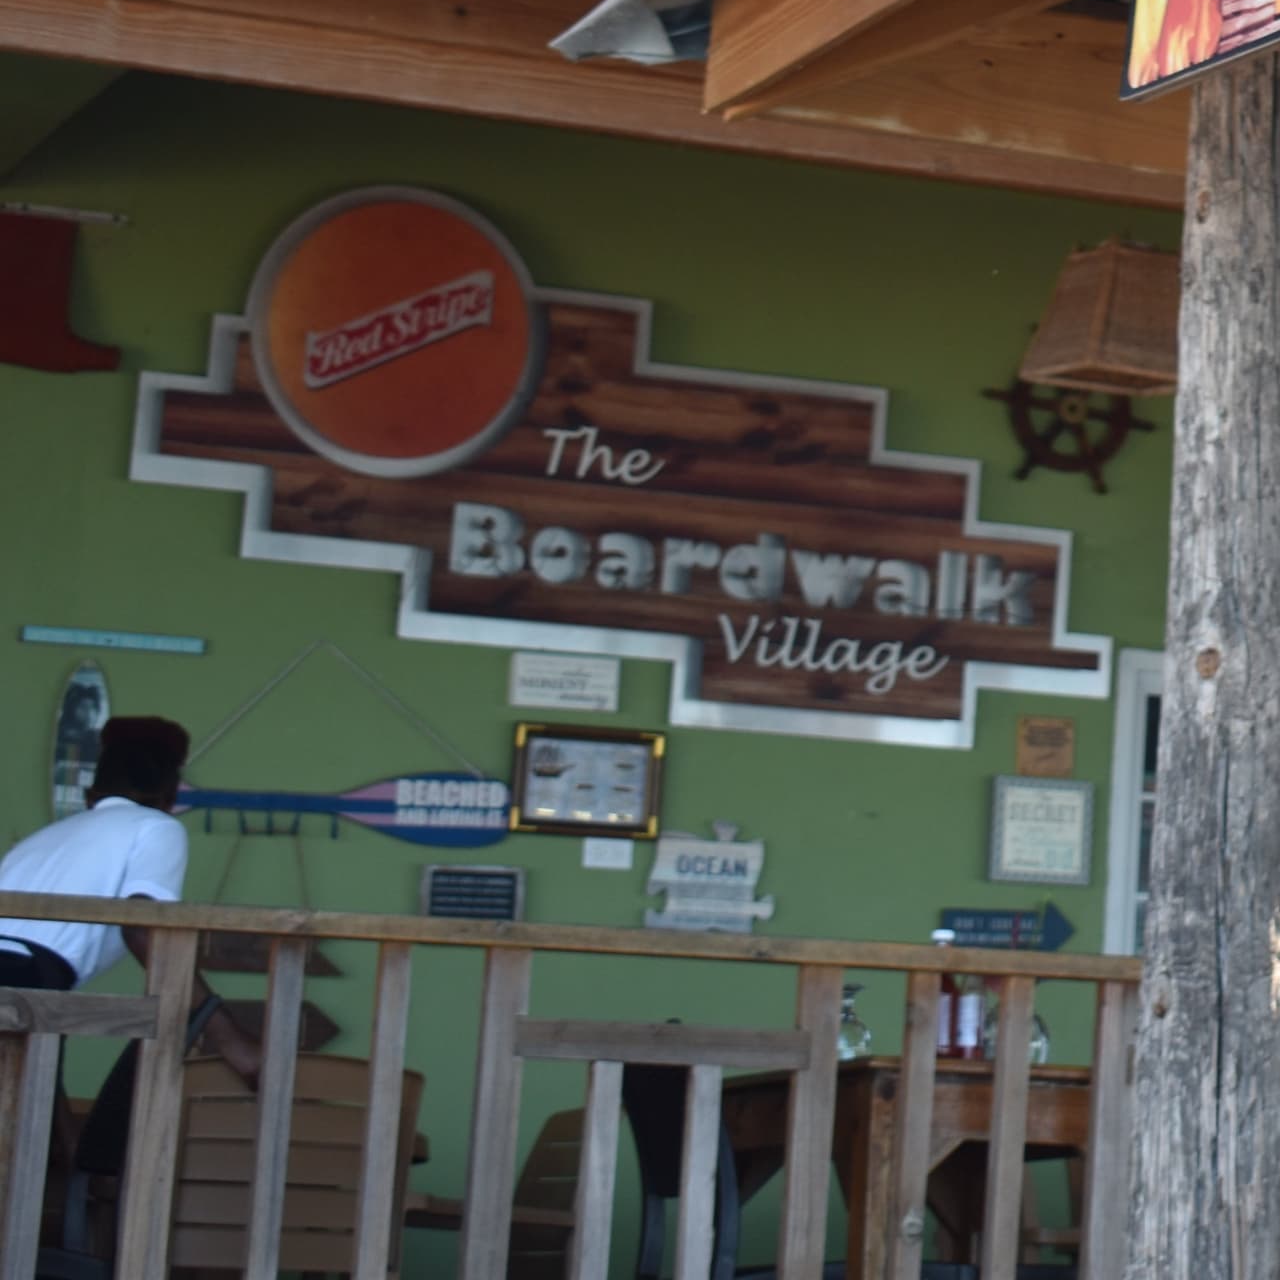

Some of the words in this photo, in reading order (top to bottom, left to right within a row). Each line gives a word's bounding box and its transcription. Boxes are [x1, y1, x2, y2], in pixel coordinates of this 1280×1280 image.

[313, 328, 382, 378] Red
[386, 282, 492, 348] Stripe
[541, 425, 667, 486] The
[450, 500, 1037, 627] Boardwalk
[718, 612, 950, 694] Village
[396, 778, 508, 809] BEACHED
[675, 852, 748, 877] OCEAN
